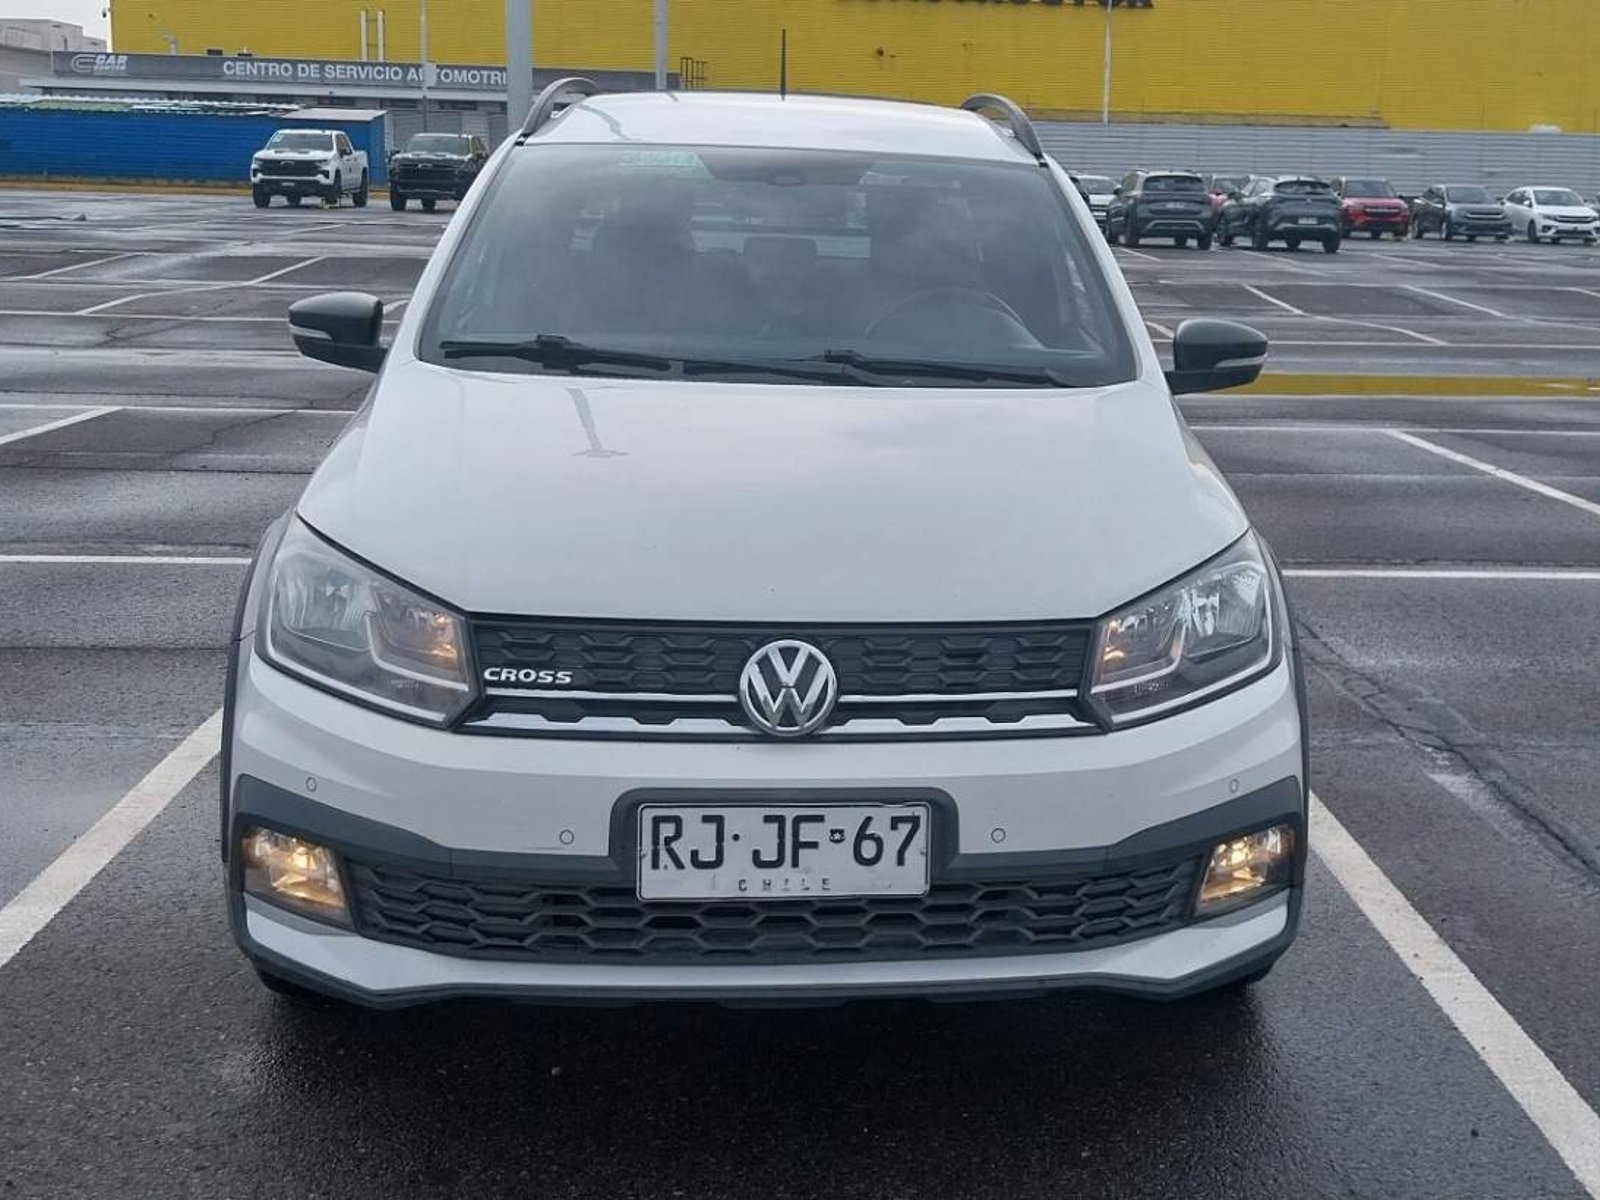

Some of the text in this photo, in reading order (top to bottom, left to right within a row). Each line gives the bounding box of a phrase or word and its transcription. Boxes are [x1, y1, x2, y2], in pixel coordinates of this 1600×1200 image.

[223, 60, 293, 77] CENTRO
[297, 63, 320, 78] DE
[324, 63, 402, 80] SERVICIO
[483, 667, 573, 684] CROSS
[738, 877, 831, 892] CHILE
